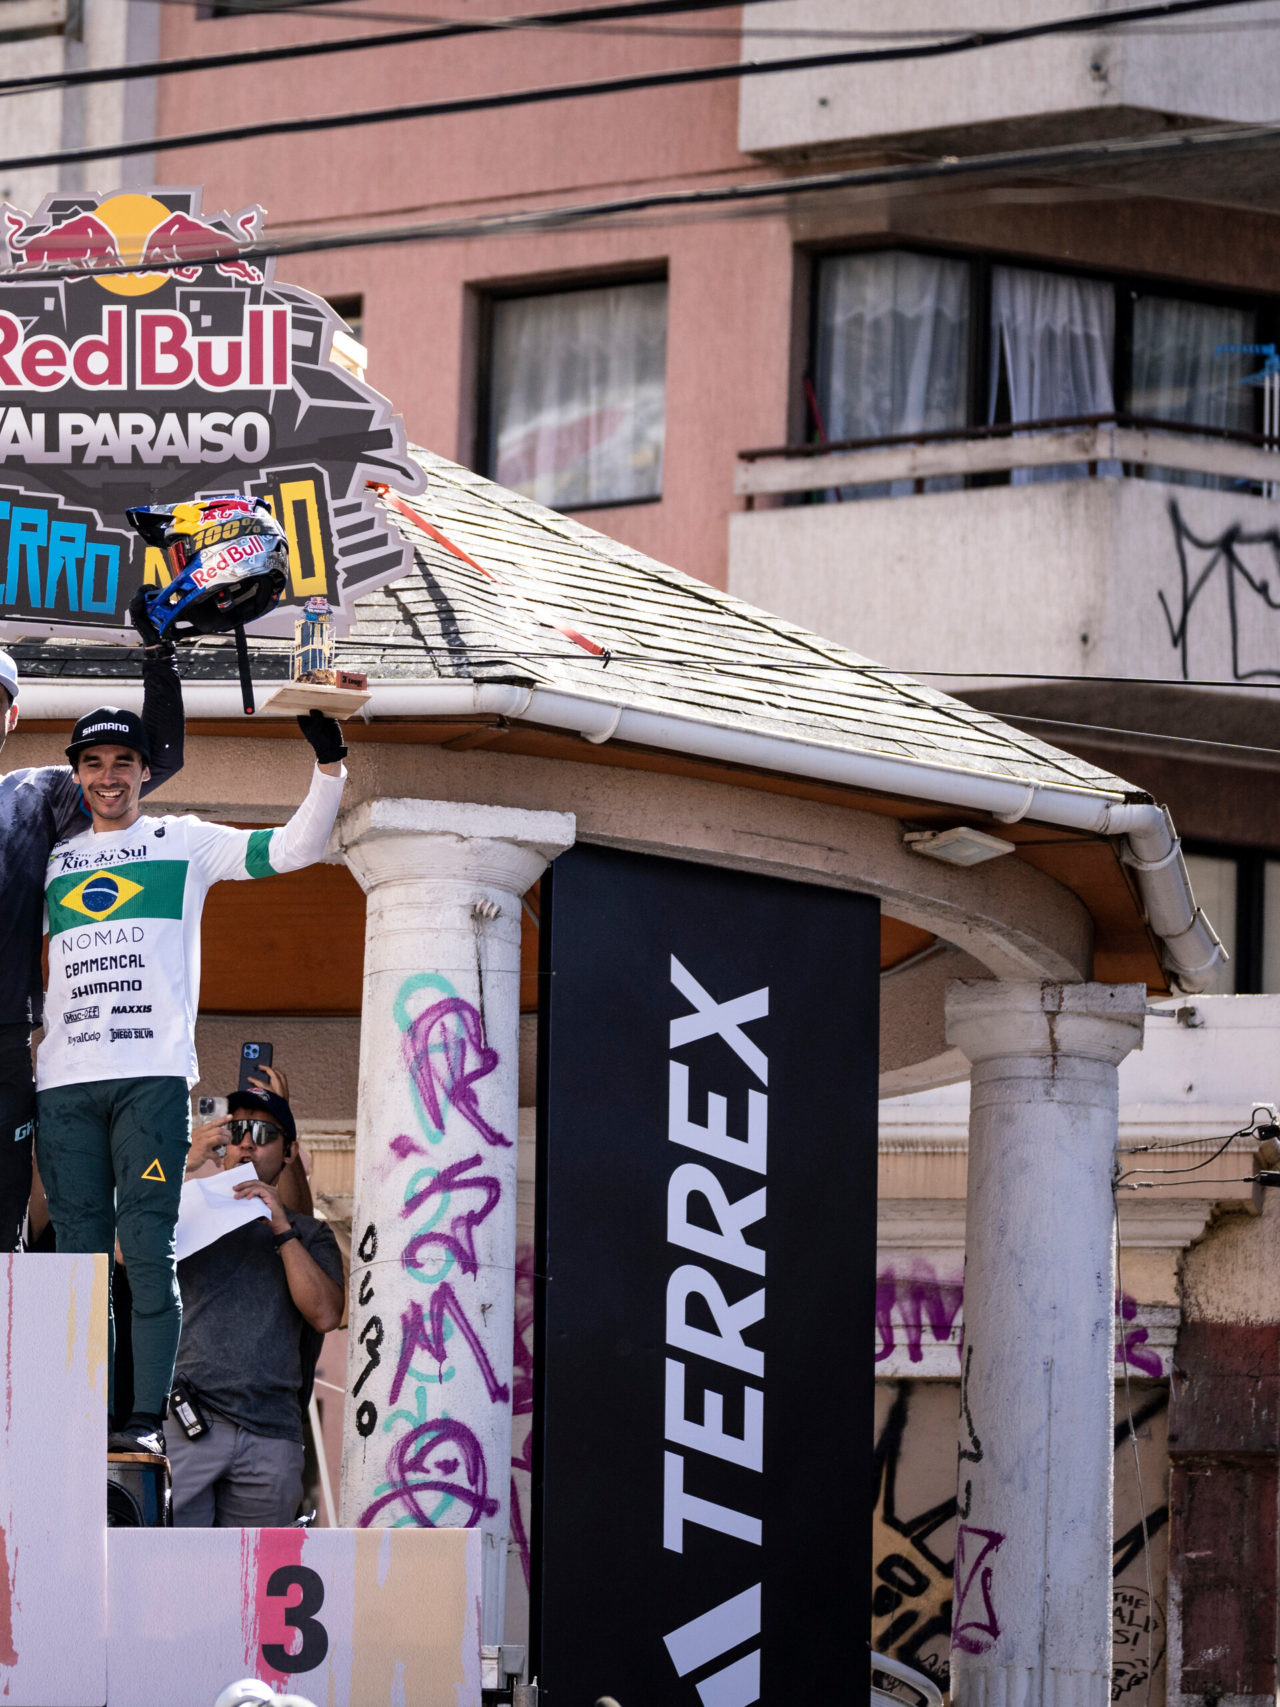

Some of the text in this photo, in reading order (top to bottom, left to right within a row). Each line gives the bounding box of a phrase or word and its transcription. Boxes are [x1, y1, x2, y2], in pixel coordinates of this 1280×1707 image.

[137, 306, 289, 389] Bull
[193, 517, 261, 550] 100%
[191, 535, 265, 589] Red Bull
[82, 722, 129, 737] SHIMANO
[61, 855, 89, 871] Rio
[117, 845, 147, 860] Sul
[62, 926, 144, 955] NOMAD
[65, 953, 146, 979] COMMENCAL
[70, 979, 143, 1000] SHIMANO
[111, 1004, 153, 1015] MAXXIS
[663, 953, 770, 1555] TERREX
[261, 1565, 329, 1673] 3
